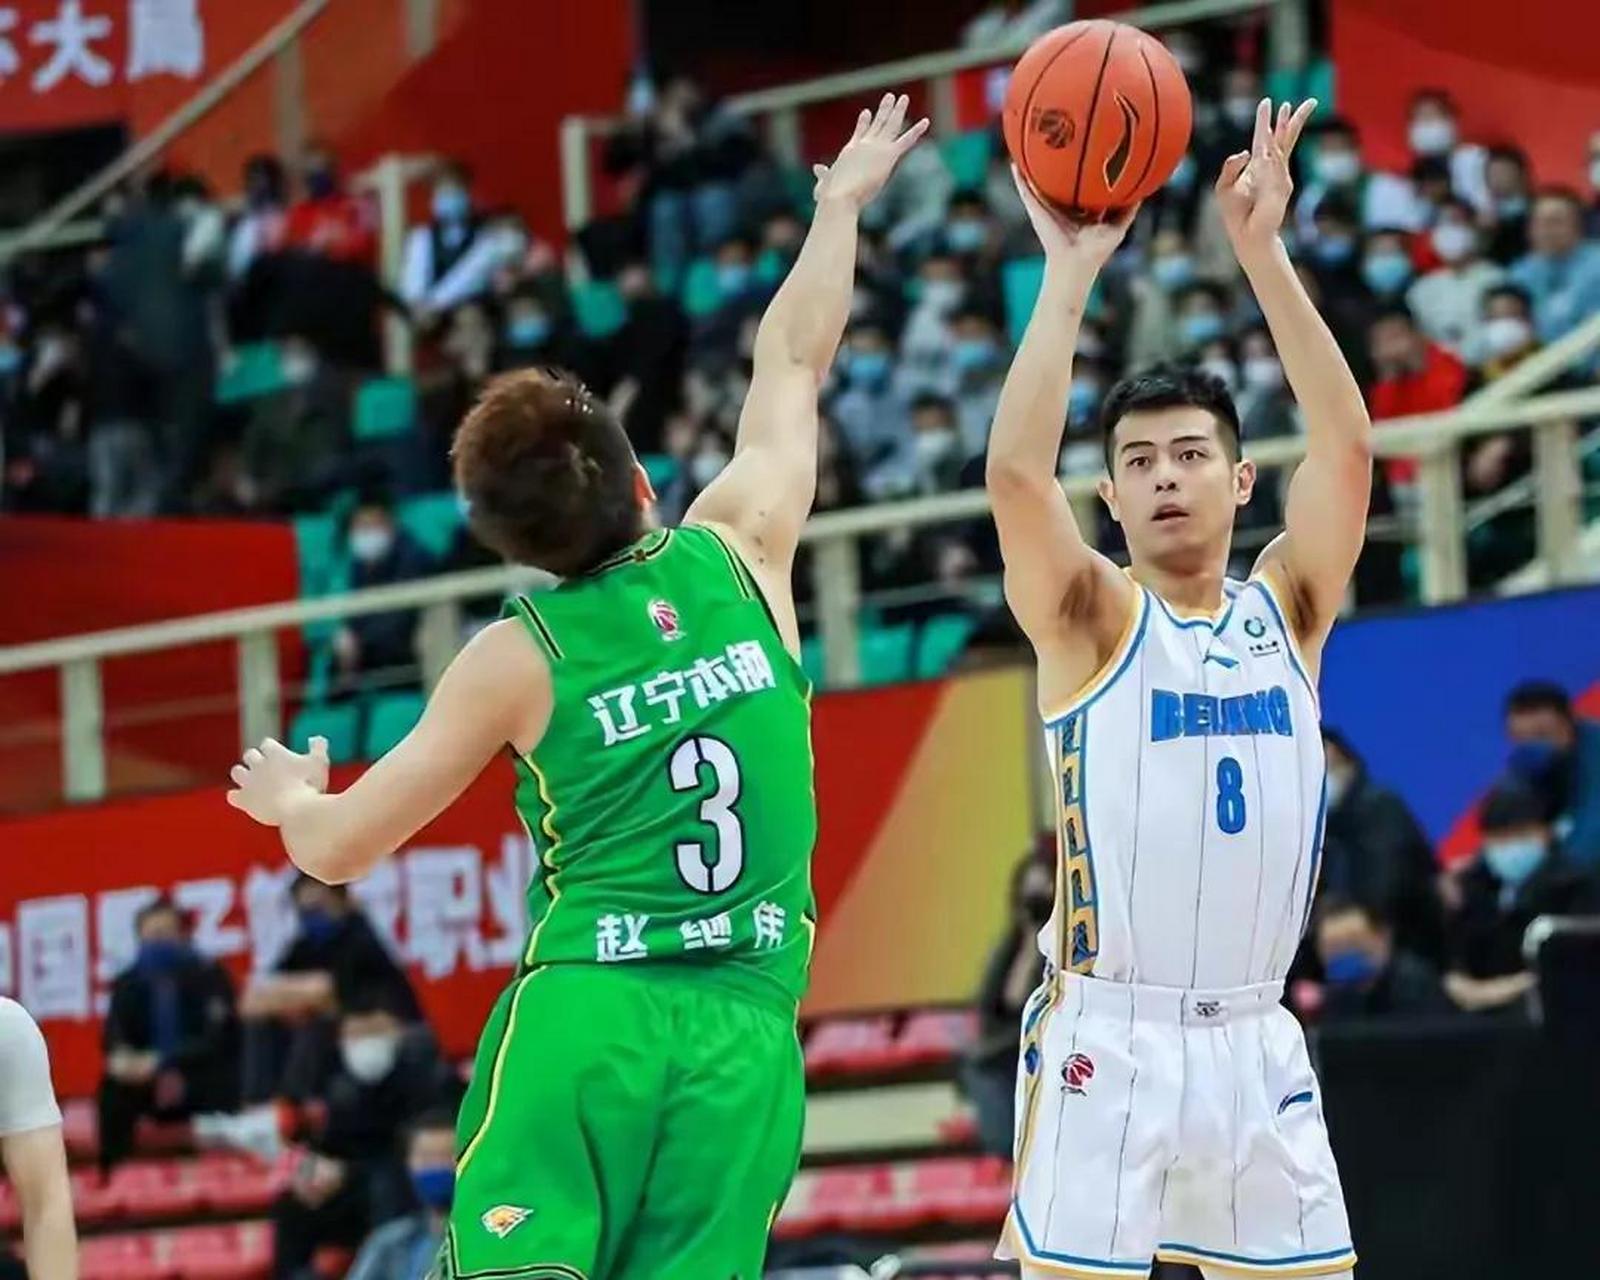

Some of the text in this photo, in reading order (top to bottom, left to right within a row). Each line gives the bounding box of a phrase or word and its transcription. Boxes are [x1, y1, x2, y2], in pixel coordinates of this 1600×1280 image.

[587, 640, 776, 746] 辽宁本钢
[667, 735, 745, 895] 3
[1217, 757, 1246, 834] 8
